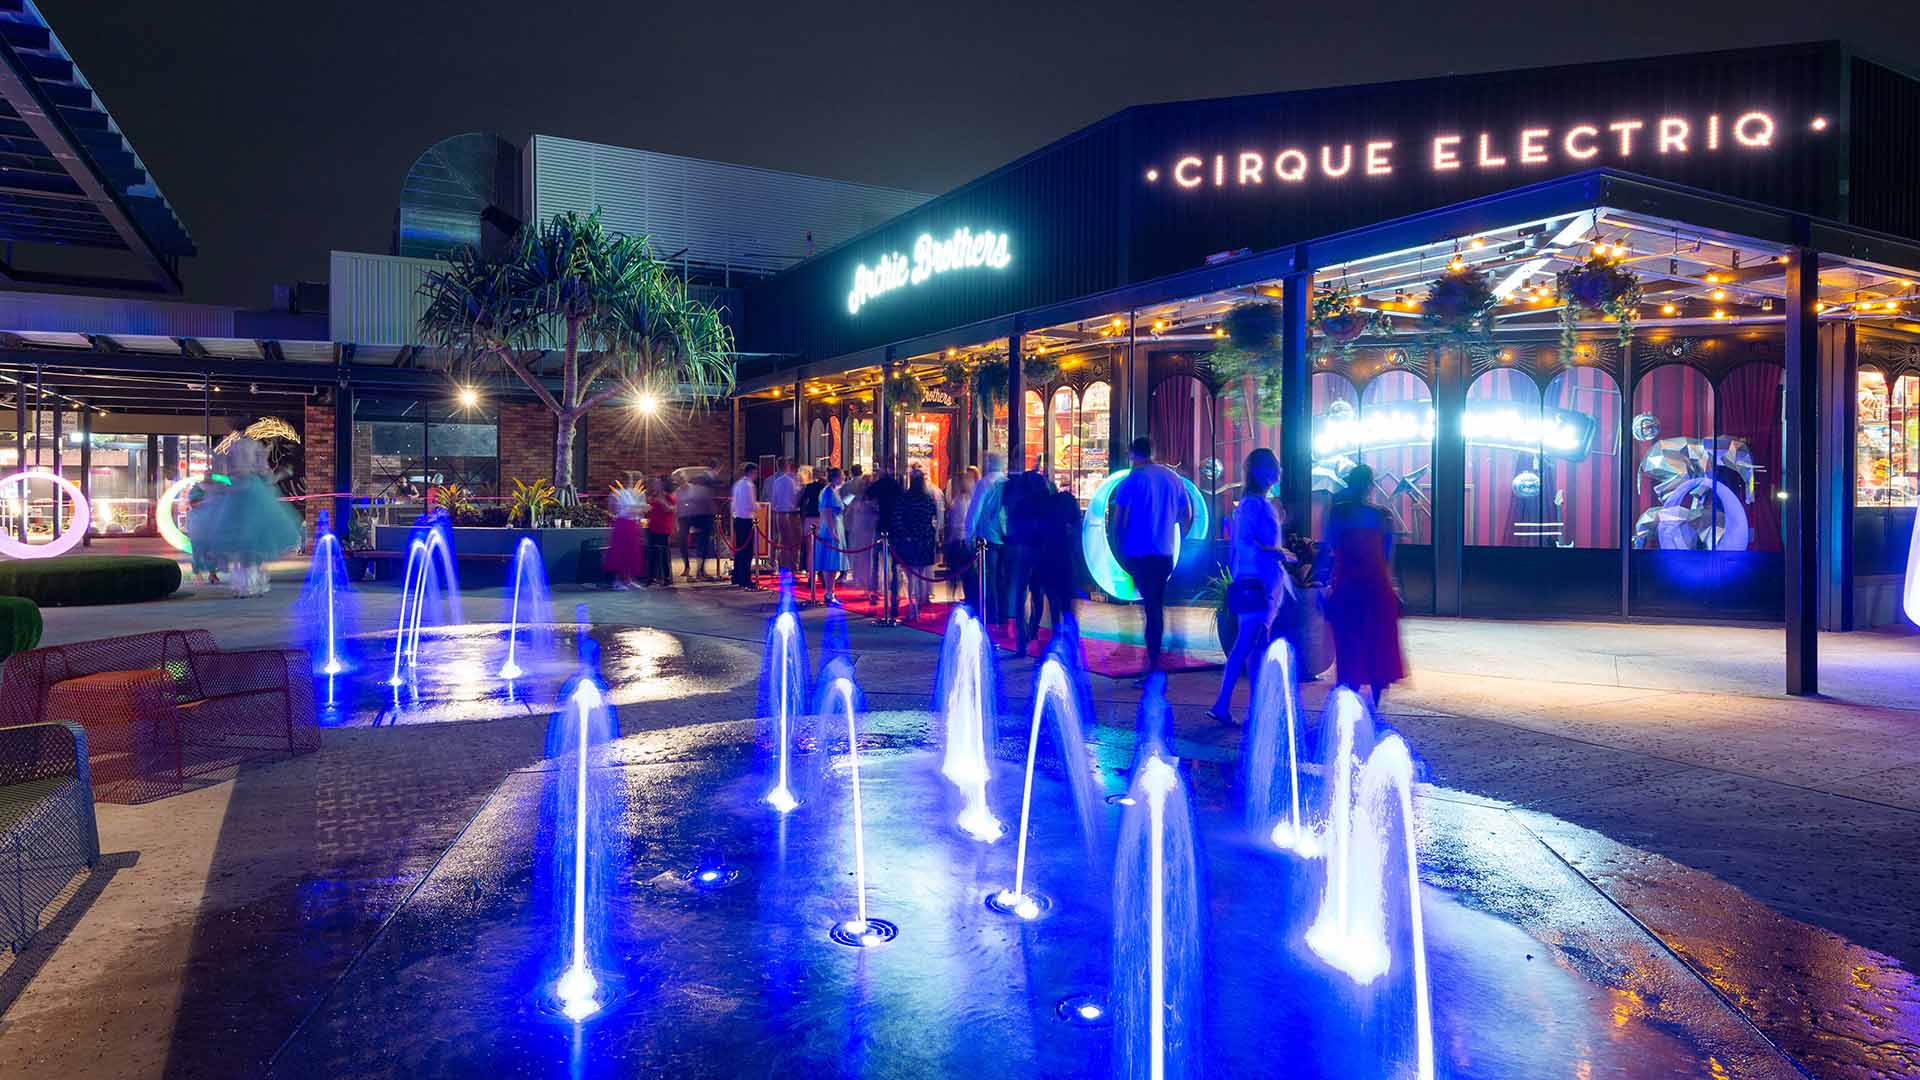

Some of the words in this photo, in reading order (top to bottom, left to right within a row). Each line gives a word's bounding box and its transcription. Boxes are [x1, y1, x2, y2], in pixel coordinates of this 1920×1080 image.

[1172, 140, 1394, 190] CIRQUE
[1430, 110, 1777, 172] ELECTRIQ
[848, 251, 909, 314] Archie
[911, 226, 1011, 285] Brothers
